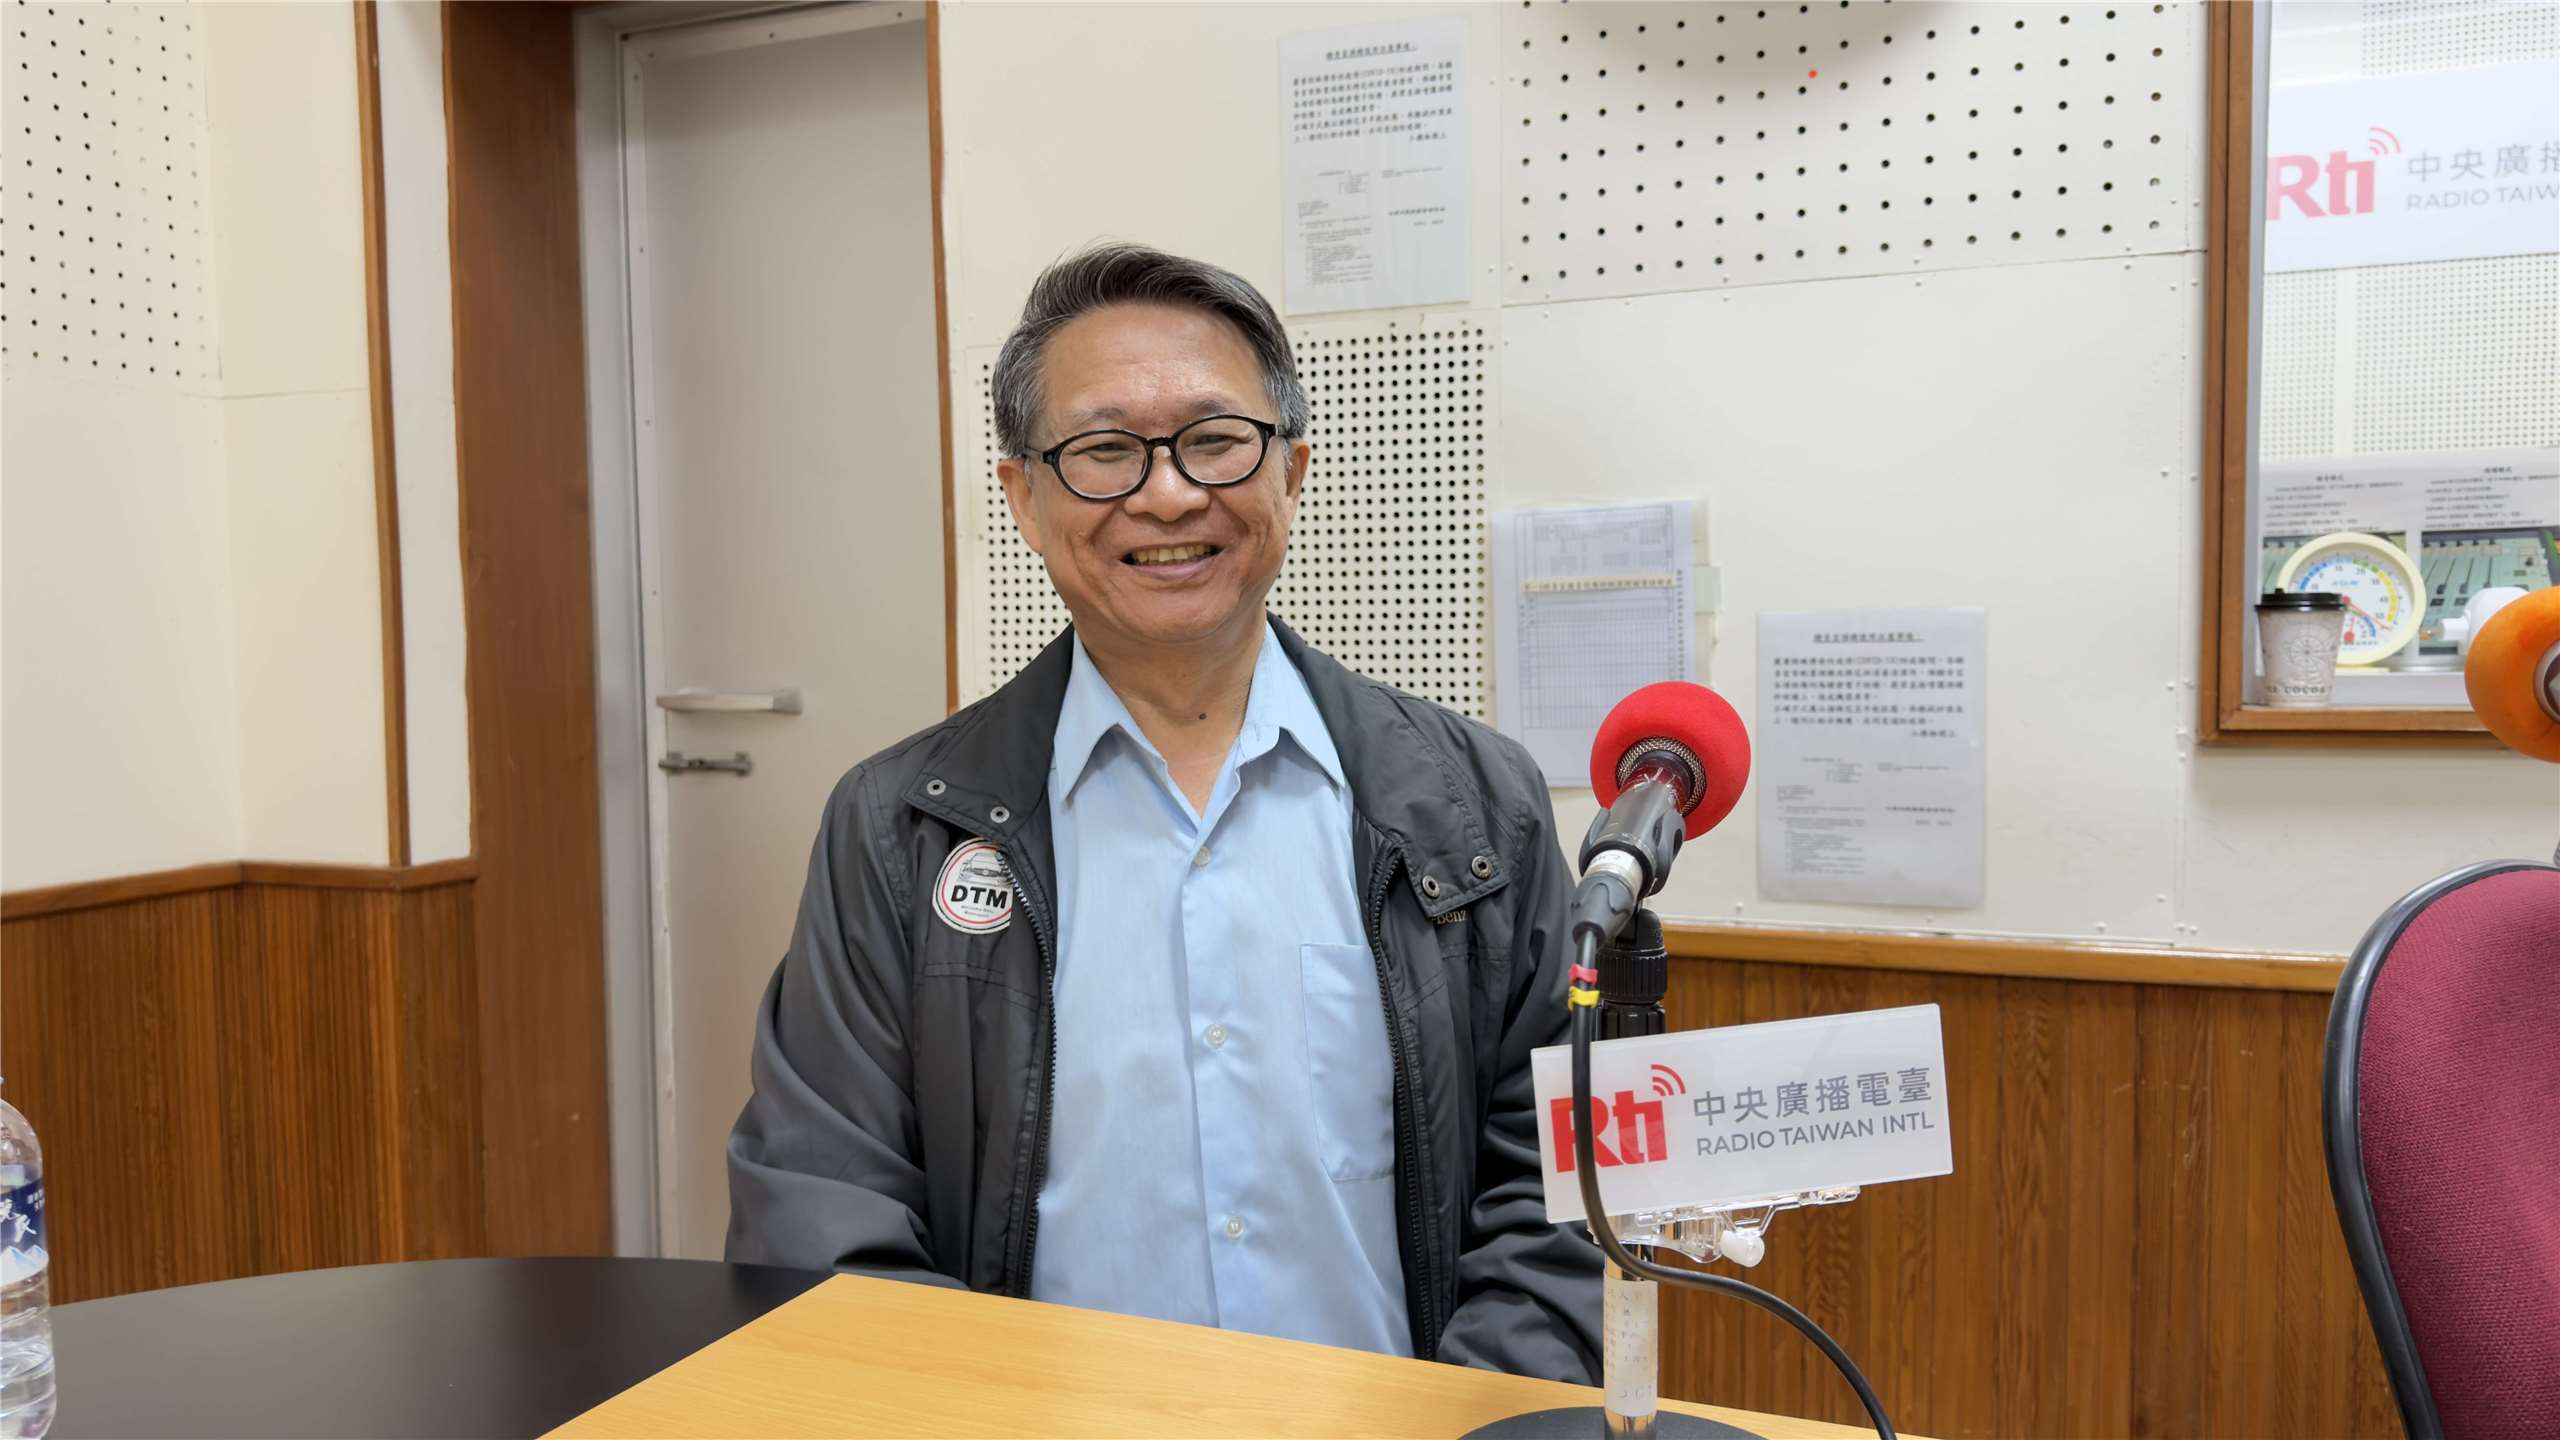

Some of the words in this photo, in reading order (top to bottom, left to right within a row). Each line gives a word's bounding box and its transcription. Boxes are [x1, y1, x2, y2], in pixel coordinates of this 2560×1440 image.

[2407, 188, 2491, 211] RADIO
[951, 885, 1008, 909] DTM
[1693, 1067, 1932, 1126] 中央廣播電臺
[1697, 1131, 1775, 1156] RADIO
[1778, 1118, 1874, 1146] TAIWAN
[1883, 1111, 1935, 1135] INTL
